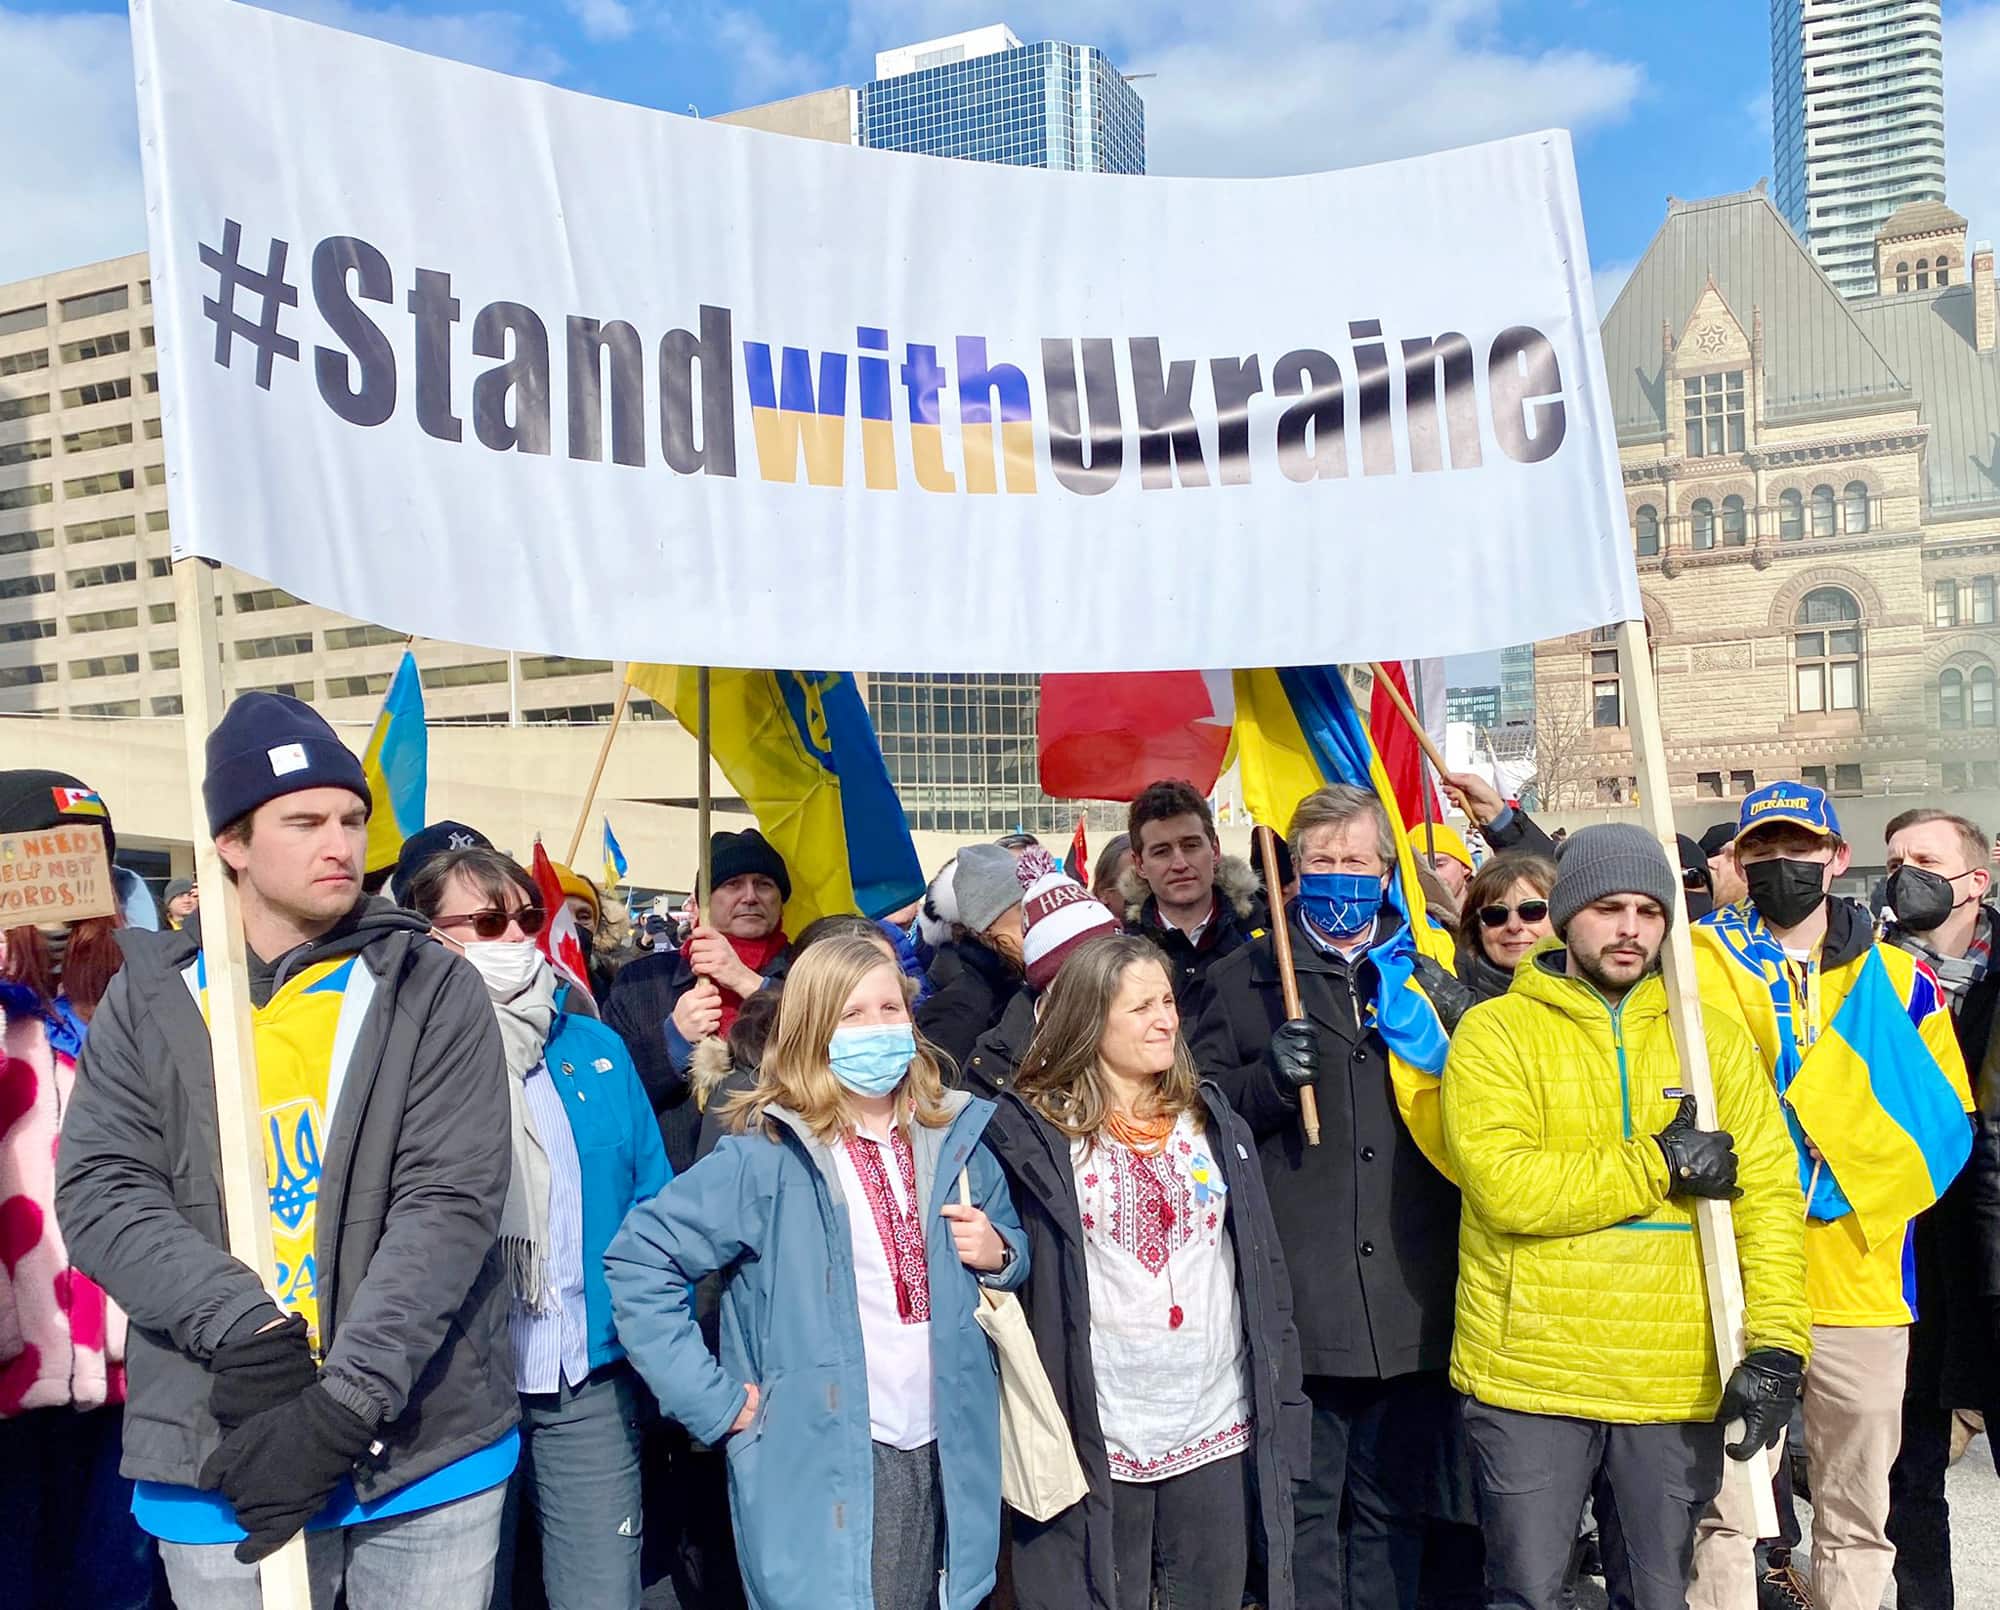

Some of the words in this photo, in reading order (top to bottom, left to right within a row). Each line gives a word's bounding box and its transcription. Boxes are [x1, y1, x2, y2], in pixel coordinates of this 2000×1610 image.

[198, 217, 1568, 497] #StandwithUkraine
[1750, 797, 1809, 816] UKRAINE
[23, 831, 101, 858] NEEDS
[0, 860, 41, 882] ELP
[47, 855, 95, 879] NOT
